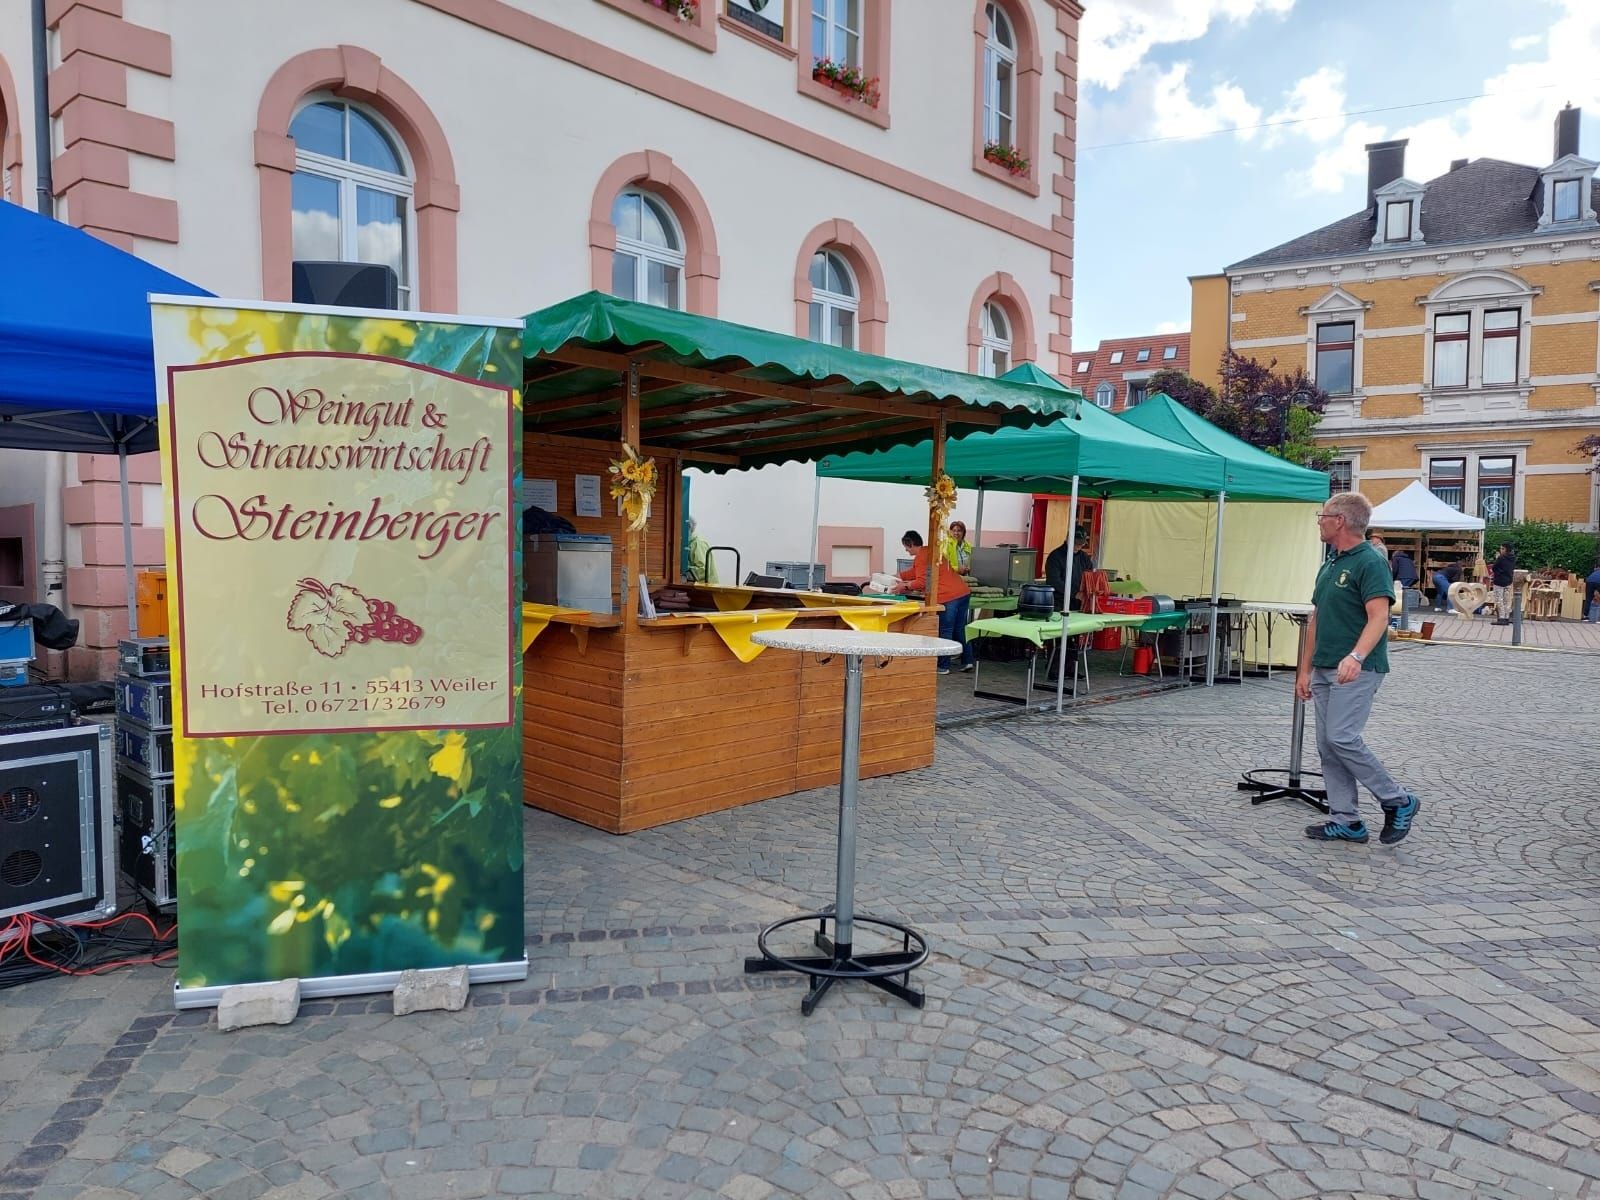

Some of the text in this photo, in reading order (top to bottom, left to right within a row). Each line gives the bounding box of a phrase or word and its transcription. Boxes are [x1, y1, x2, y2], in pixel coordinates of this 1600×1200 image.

[247, 386, 448, 442] Weingut &
[196, 431, 493, 485] Strausswirtschaft
[192, 494, 501, 560] Steinberger
[201, 681, 313, 698] Hofstraße
[319, 681, 341, 695] 11
[366, 679, 424, 695] 55413
[430, 677, 498, 692] Weiler
[261, 699, 299, 714] Tel.
